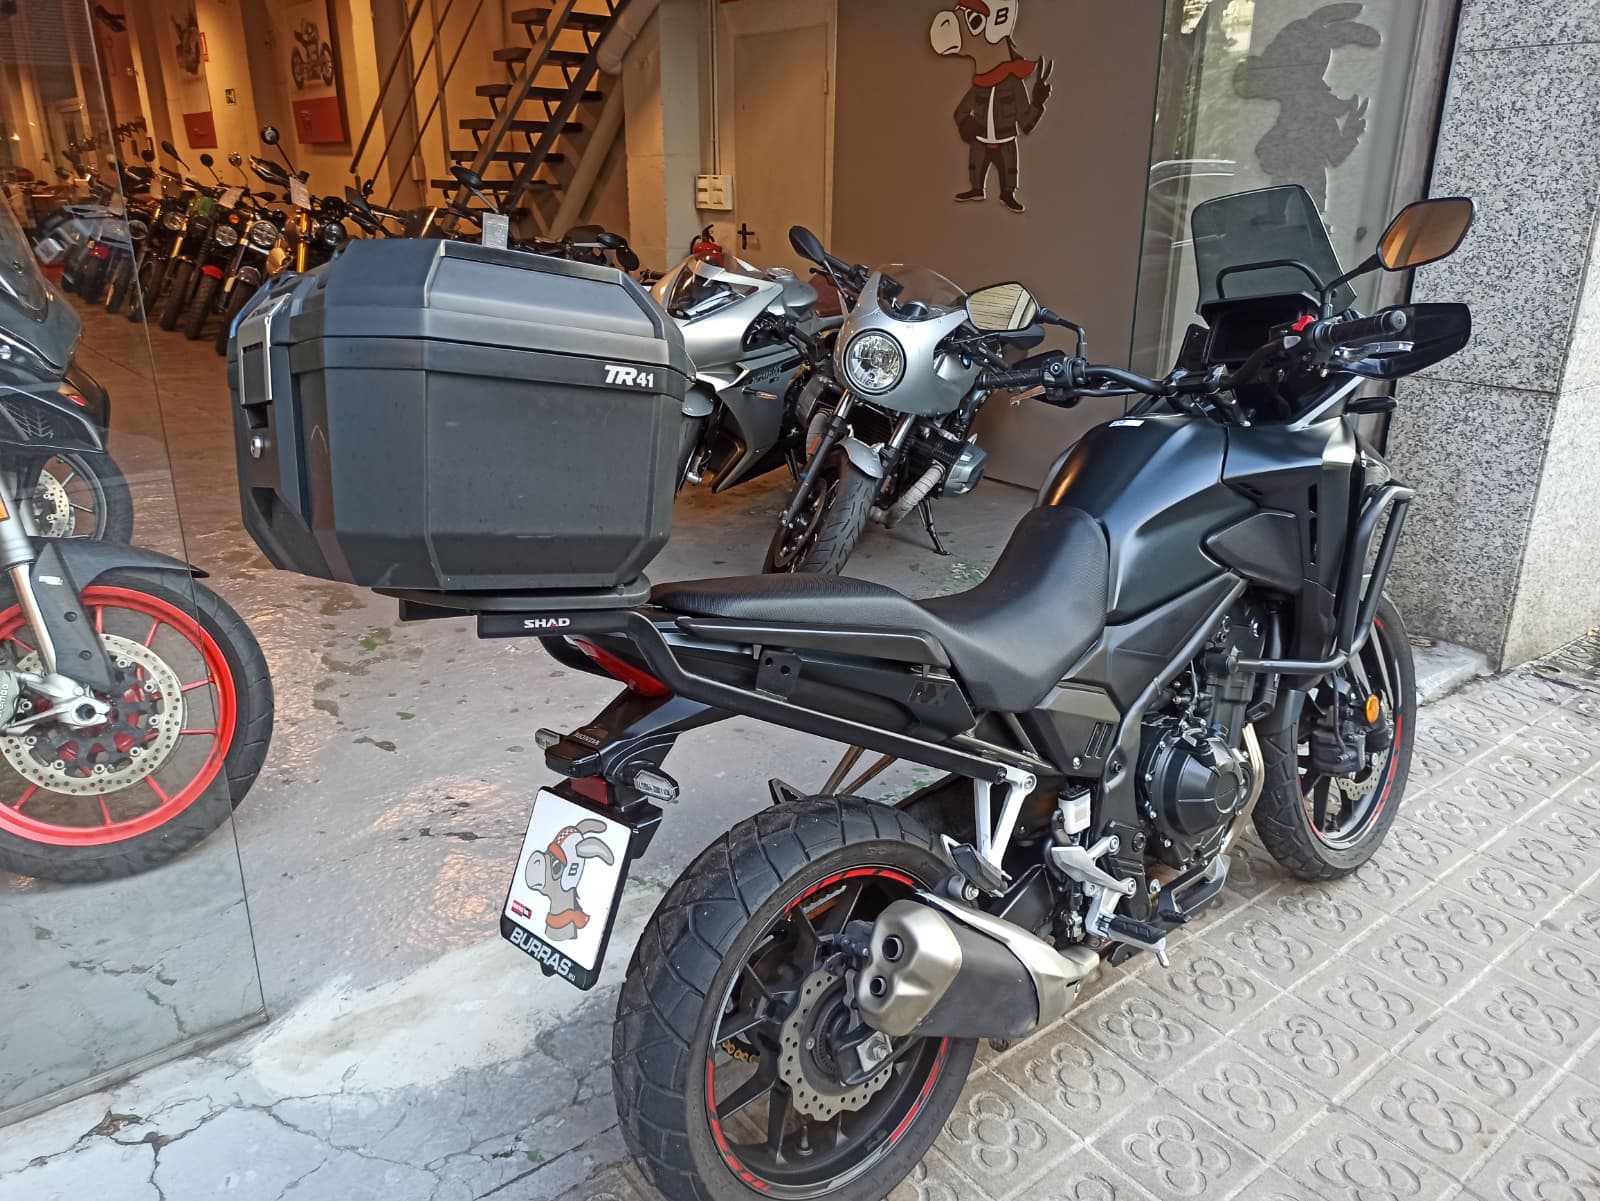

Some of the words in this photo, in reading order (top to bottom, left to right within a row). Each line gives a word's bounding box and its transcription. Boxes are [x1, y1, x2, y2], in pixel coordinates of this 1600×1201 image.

[994, 6, 1009, 25] B
[523, 617, 570, 629] SHAD
[567, 862, 580, 876] B
[510, 927, 572, 976] BURRAS
